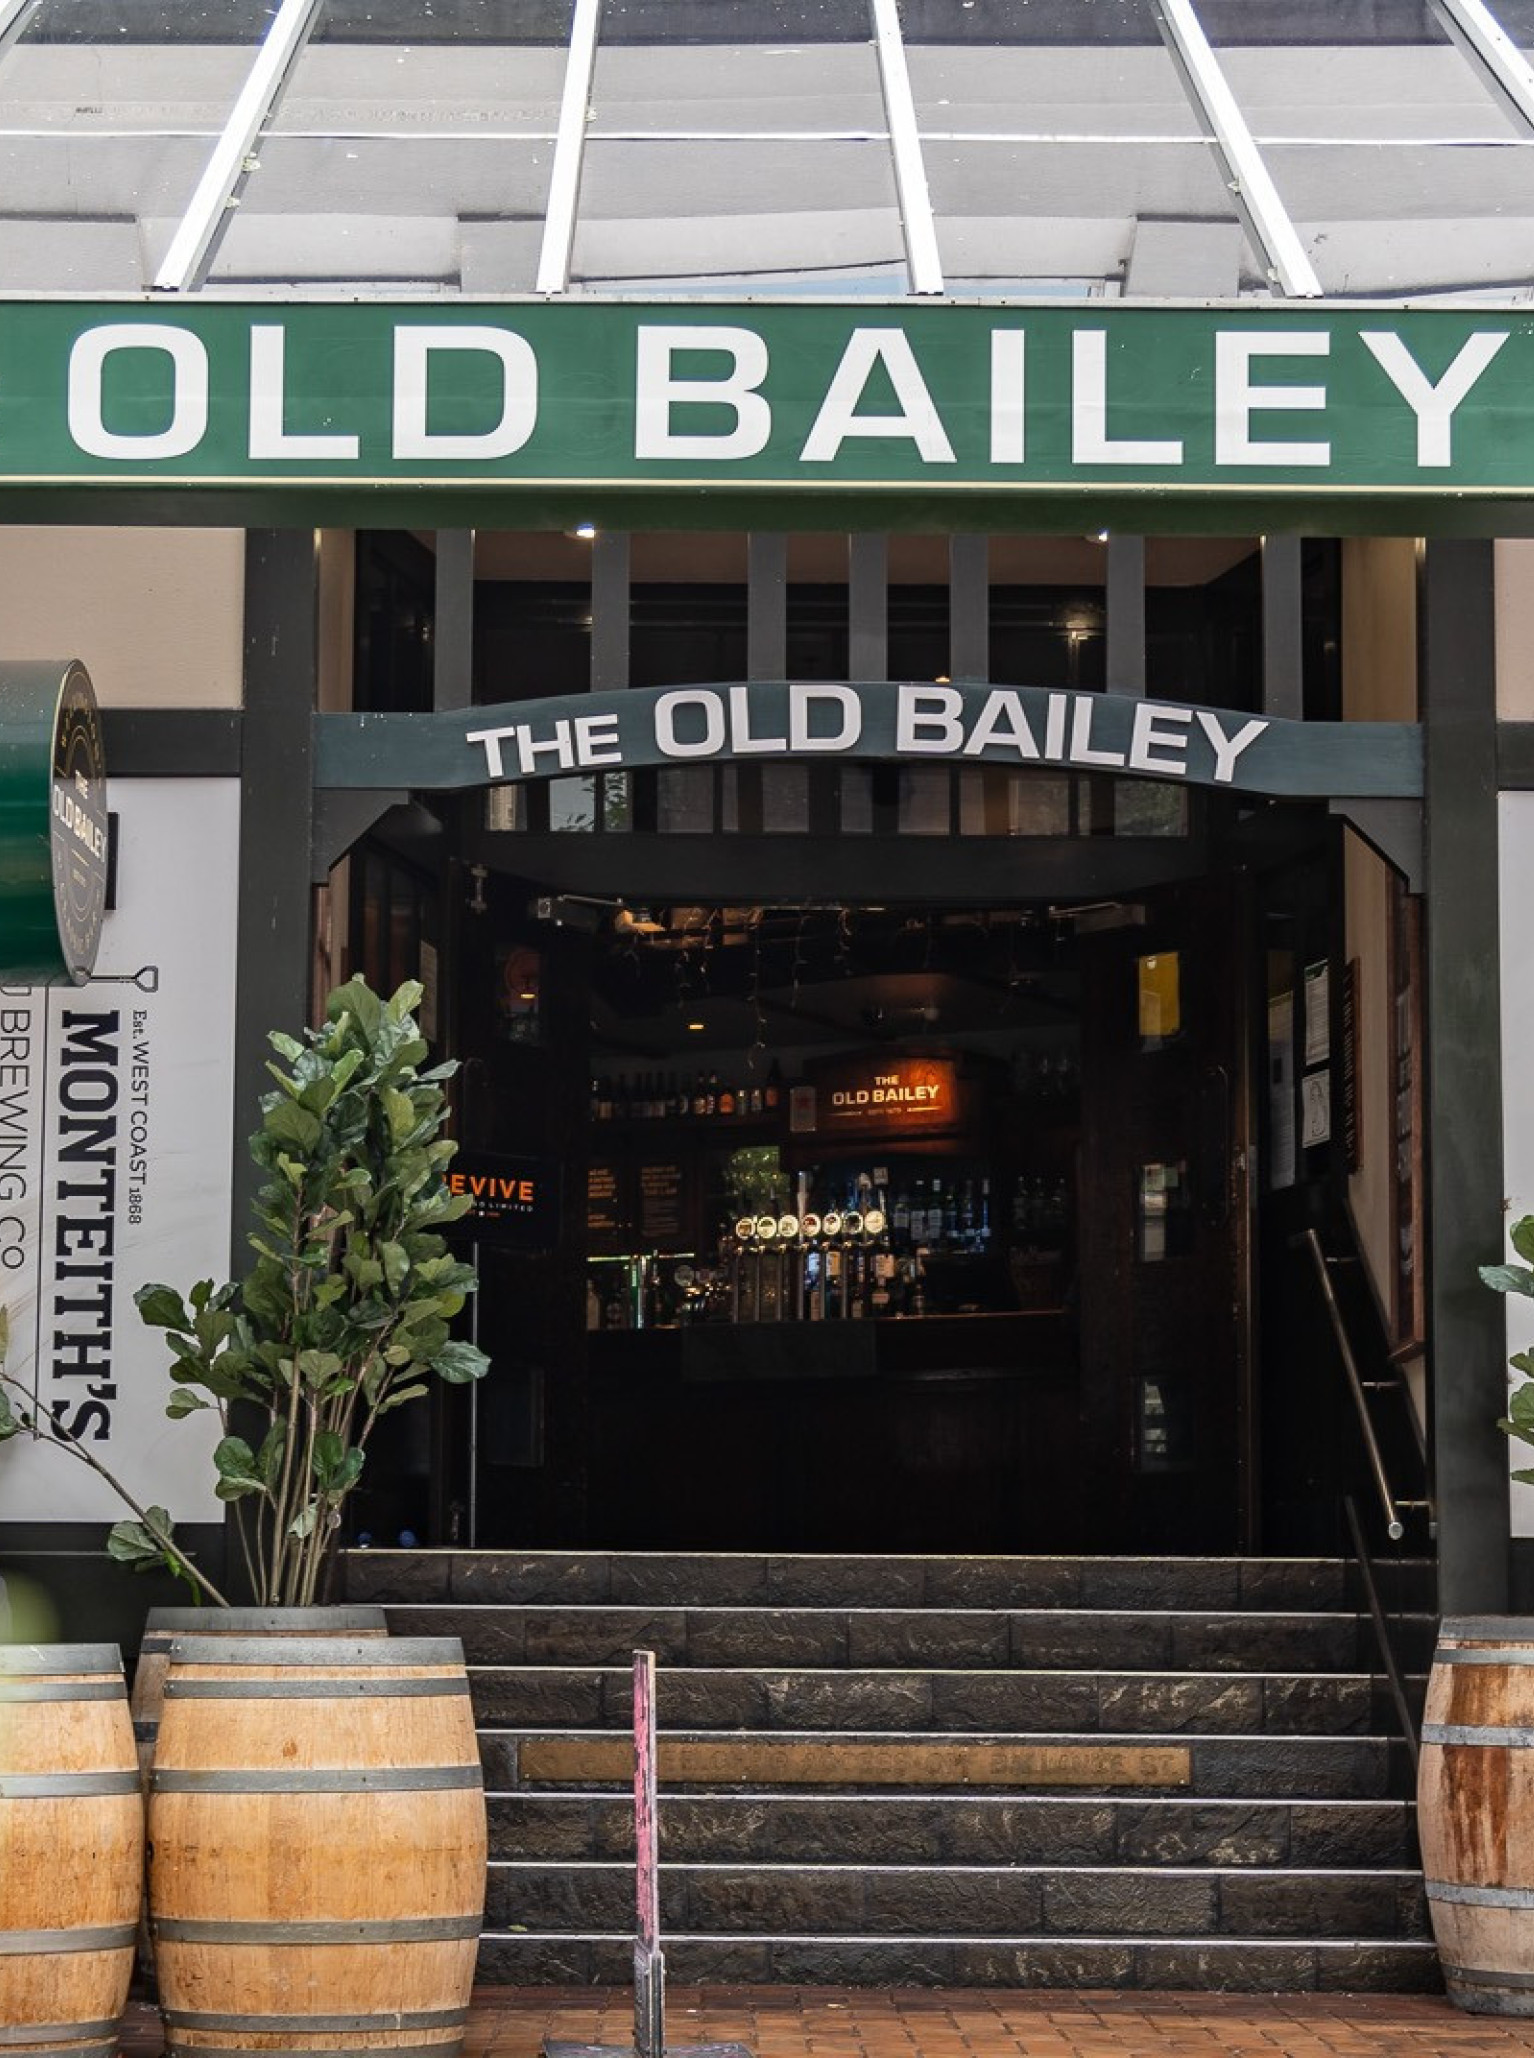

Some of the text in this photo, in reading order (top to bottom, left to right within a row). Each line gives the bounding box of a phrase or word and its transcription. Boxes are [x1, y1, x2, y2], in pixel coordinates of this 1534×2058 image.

[67, 323, 1511, 468] OLD BAILEY
[466, 684, 1270, 783] THE OLD BAILEY
[132, 1009, 148, 1039] Est.
[0, 1009, 31, 1201] BREWING
[131, 1040, 150, 1106] WEST
[832, 1084, 940, 1106] OLD BAILEY
[873, 1074, 900, 1086] THE
[129, 1110, 148, 1185] COAST
[0, 1216, 26, 1270] CO
[50, 1009, 120, 1441] MONTEITH'S
